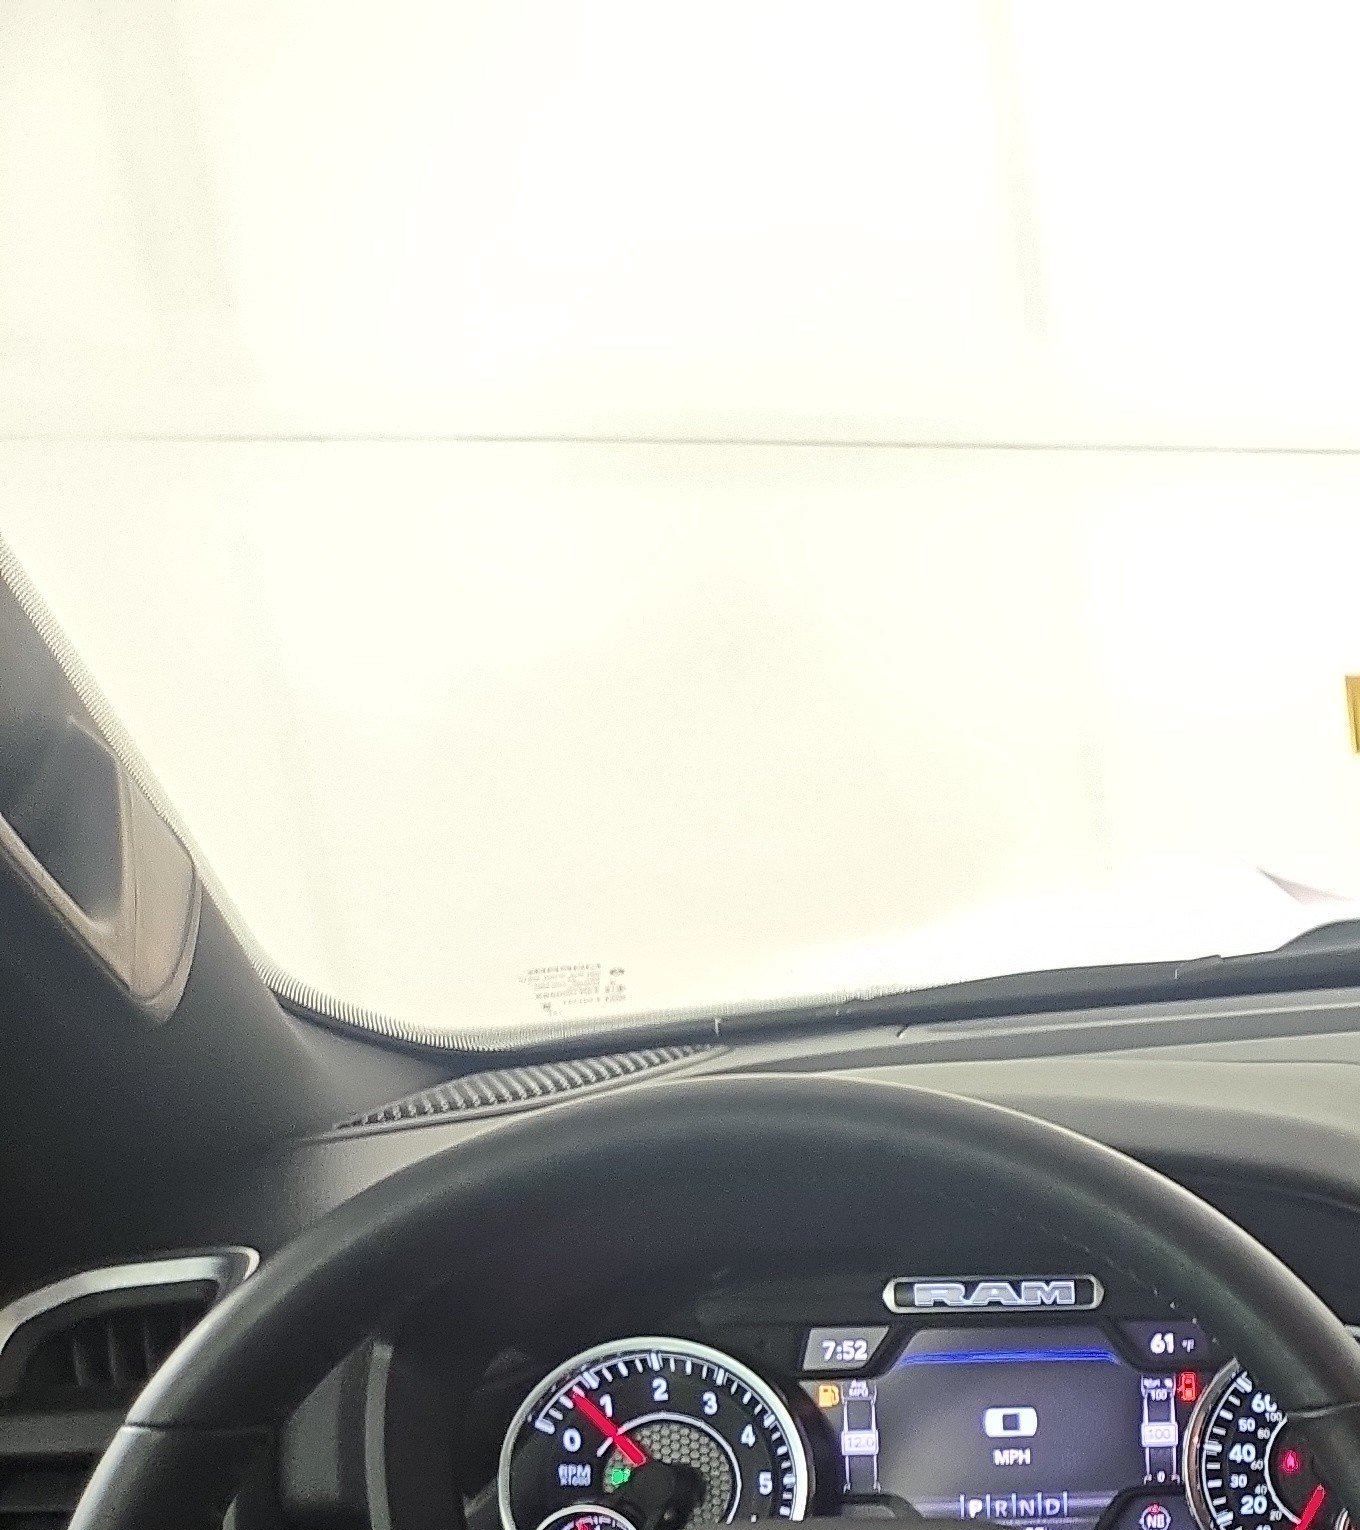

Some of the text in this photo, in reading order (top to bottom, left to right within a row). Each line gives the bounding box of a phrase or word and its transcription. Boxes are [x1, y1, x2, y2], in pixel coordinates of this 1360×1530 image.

[914, 1280, 1076, 1307] RAM
[822, 1339, 868, 1362] 7:52
[1150, 1332, 1174, 1354] 61
[652, 1377, 669, 1401] 2
[600, 1393, 614, 1417] 1
[703, 1391, 718, 1415] 3
[741, 1423, 756, 1446] 4
[1238, 1417, 1256, 1432] 50
[562, 1428, 582, 1452] 0
[847, 1437, 874, 1448] 12.0
[994, 1449, 1031, 1466] MPH
[1228, 1443, 1256, 1464] 40
[759, 1471, 773, 1495] 5
[1228, 1473, 1248, 1489] 30
[969, 1498, 1060, 1519] P R N D
[1240, 1495, 1268, 1515] 20
